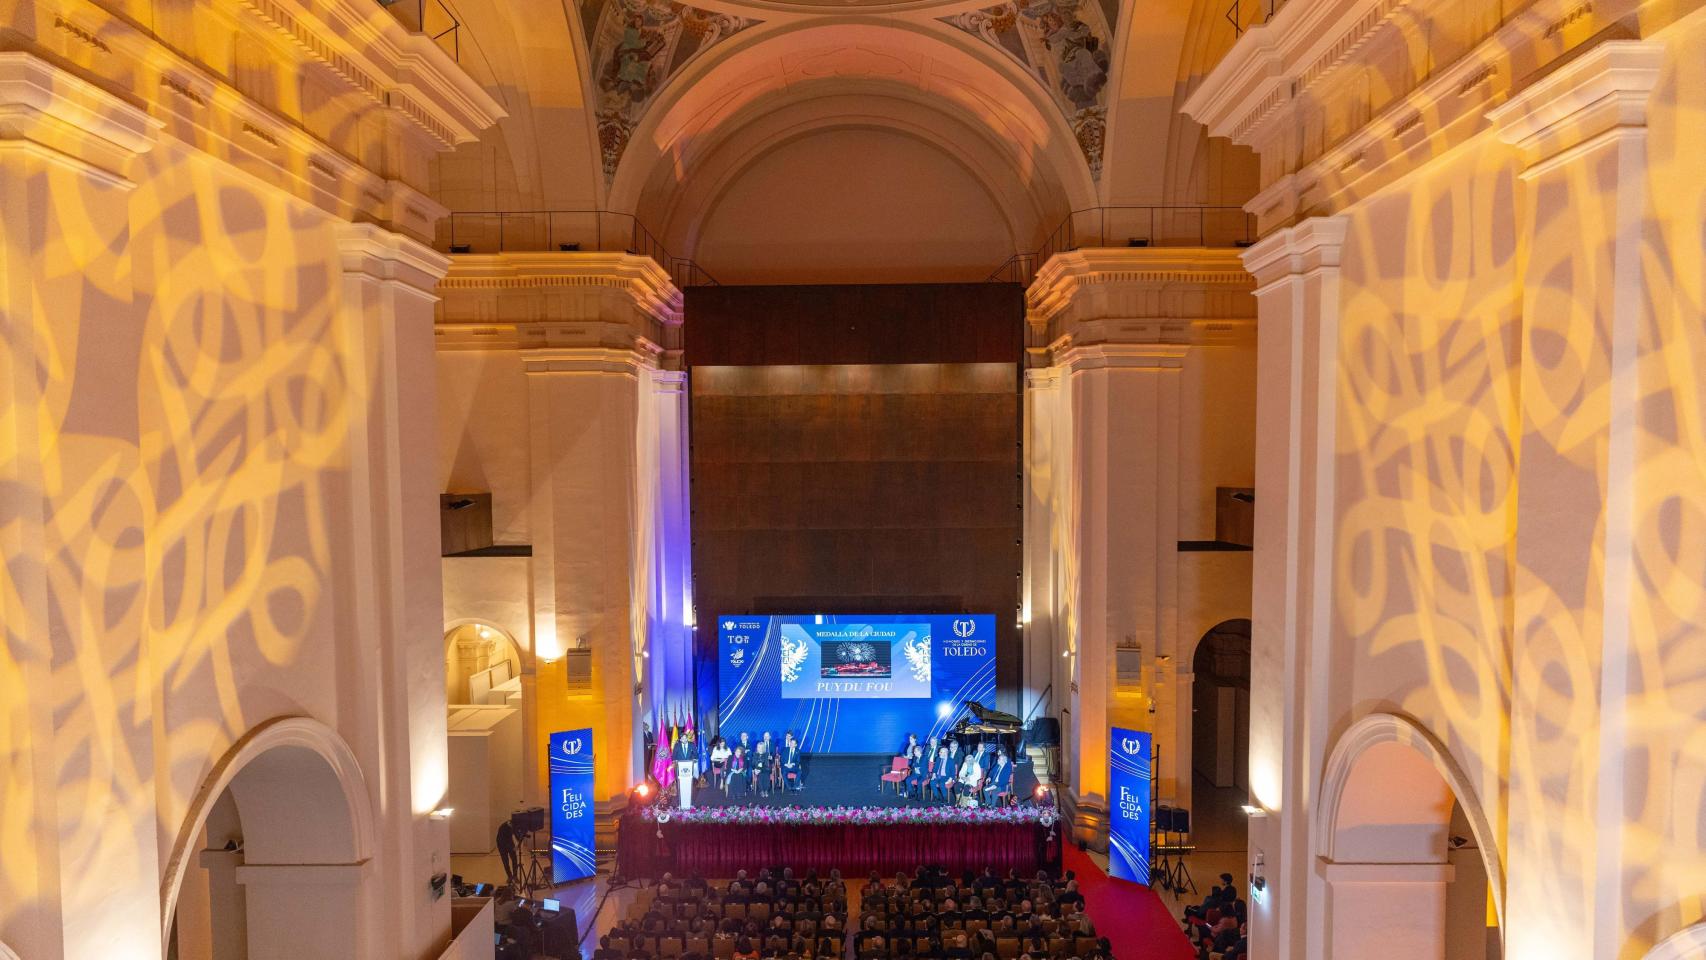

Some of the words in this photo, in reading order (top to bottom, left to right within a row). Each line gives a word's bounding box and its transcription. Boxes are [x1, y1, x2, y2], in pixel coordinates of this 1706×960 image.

[943, 647, 987, 656] TOLEDO
[817, 682, 840, 692] PUY
[843, 682, 863, 692] DU
[866, 682, 893, 692] FOU
[562, 788, 582, 803] FELI
[1119, 786, 1139, 803] FELI
[562, 801, 586, 812] CIDA
[1119, 801, 1143, 813] CIDA
[566, 809, 583, 820] DES
[1122, 809, 1139, 821] DES
